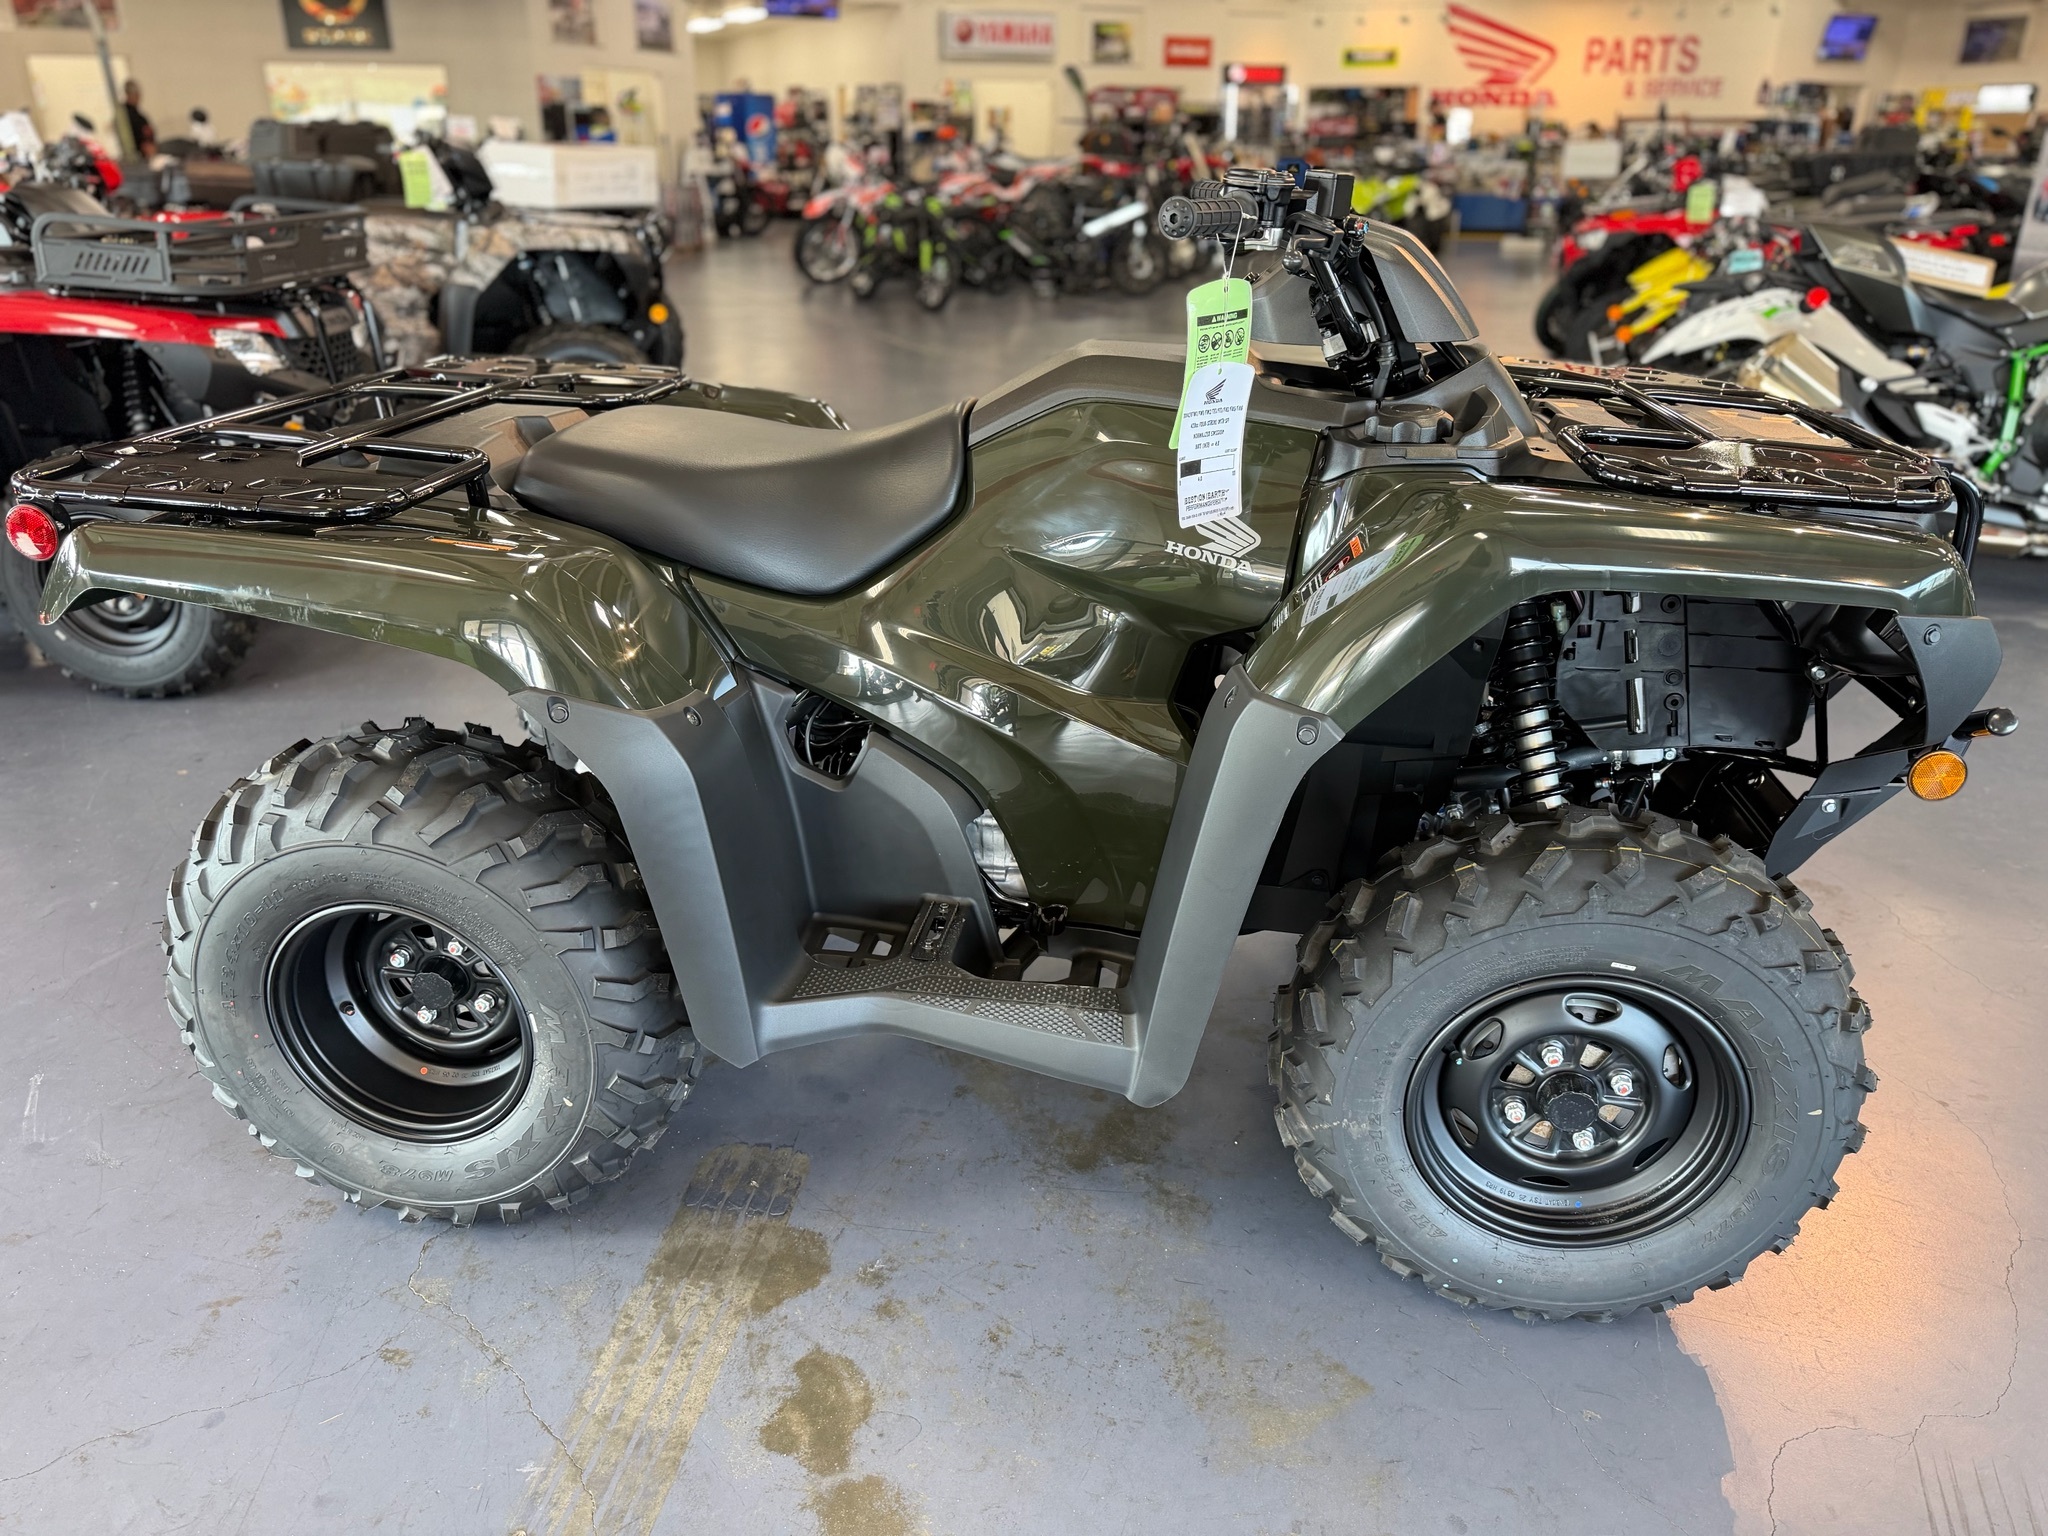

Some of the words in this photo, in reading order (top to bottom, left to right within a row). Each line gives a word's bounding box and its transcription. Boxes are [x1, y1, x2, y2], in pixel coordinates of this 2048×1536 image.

[978, 21, 1053, 45] YAMAHA
[1583, 36, 1700, 75] PARTS
[1430, 87, 1556, 107] HONDA
[1164, 540, 1254, 574] HONDA
[1661, 963, 1801, 1181] MAXXIS
[463, 1001, 568, 1182] MAXXIS
